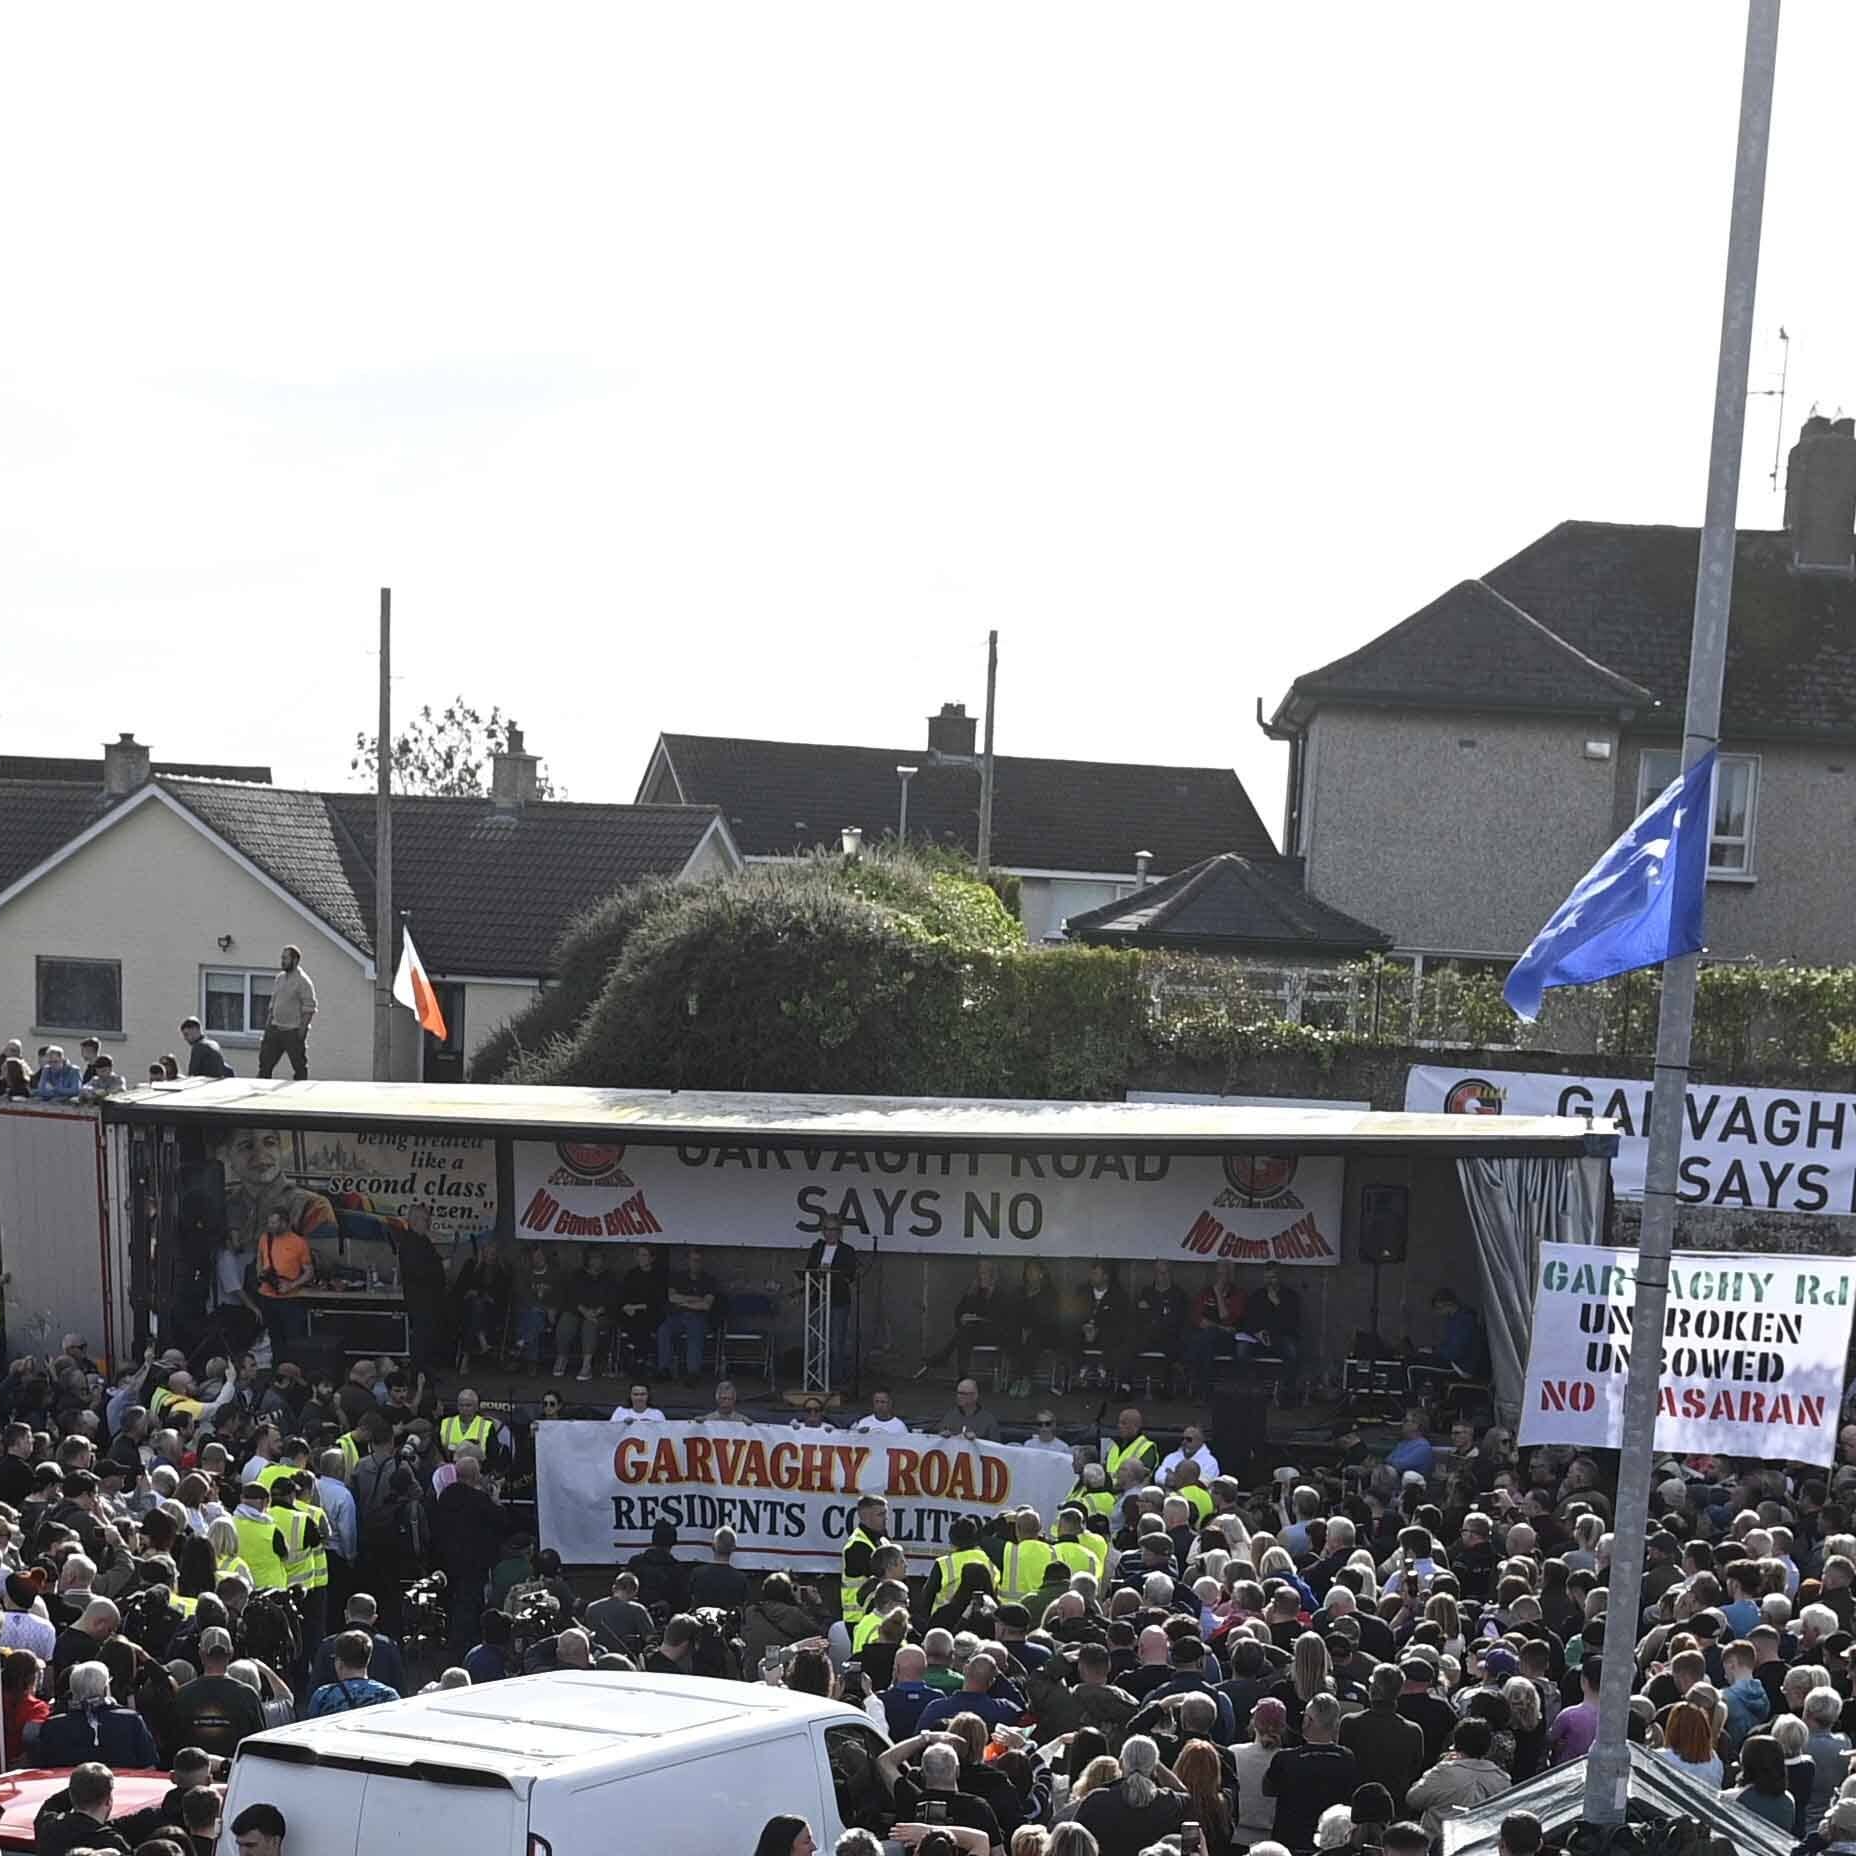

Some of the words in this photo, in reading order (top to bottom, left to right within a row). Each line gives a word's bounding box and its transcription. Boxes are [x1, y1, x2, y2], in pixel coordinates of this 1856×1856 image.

[410, 1151, 446, 1169] like
[451, 1156, 465, 1170] a
[1679, 1156, 1829, 1211] SAYS
[329, 1173, 416, 1195] second
[423, 1174, 487, 1198] class
[520, 1187, 551, 1231] NO
[603, 1190, 664, 1237] BACK
[796, 1186, 943, 1238] SAYS
[964, 1191, 1043, 1240] NO
[1181, 1208, 1219, 1250] NO
[1272, 1212, 1335, 1260] BACK
[1543, 1260, 1774, 1302] GARAGHY
[1795, 1274, 1849, 1306] Rd
[1579, 1303, 1802, 1344] UNROKEN
[1540, 1380, 1596, 1411] NO
[1624, 1384, 1825, 1426] ASARAN
[612, 1437, 872, 1495] GARVAGHY
[886, 1447, 1013, 1505] ROAD
[610, 1495, 807, 1538] RESIDENTS
